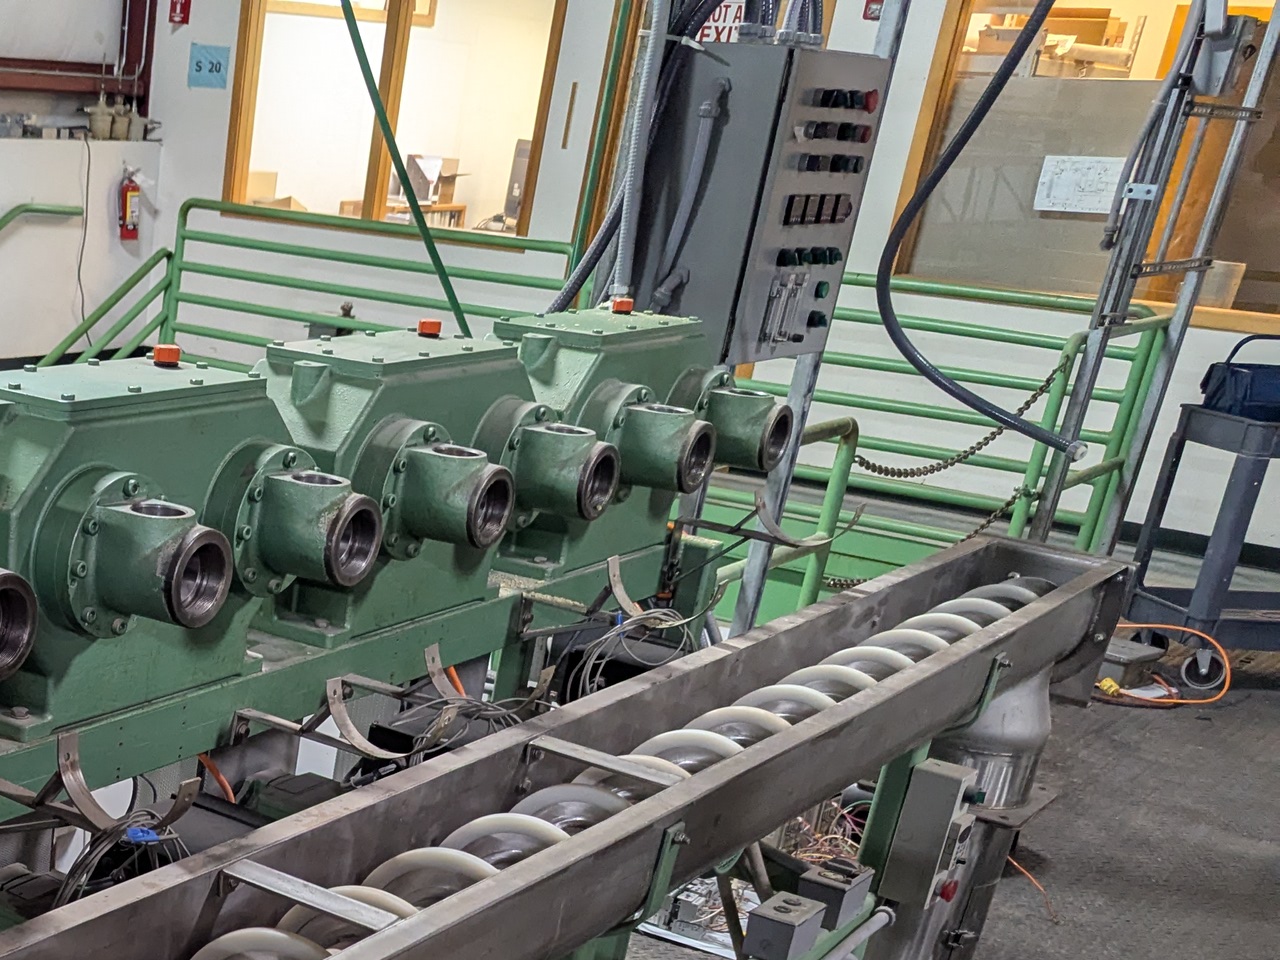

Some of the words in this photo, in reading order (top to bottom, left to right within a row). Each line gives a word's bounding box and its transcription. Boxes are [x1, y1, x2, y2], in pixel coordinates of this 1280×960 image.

[707, 5, 731, 23] OT
[733, 5, 742, 23] A
[699, 26, 738, 43] EXI
[195, 61, 202, 73] S
[208, 61, 221, 73] 20
